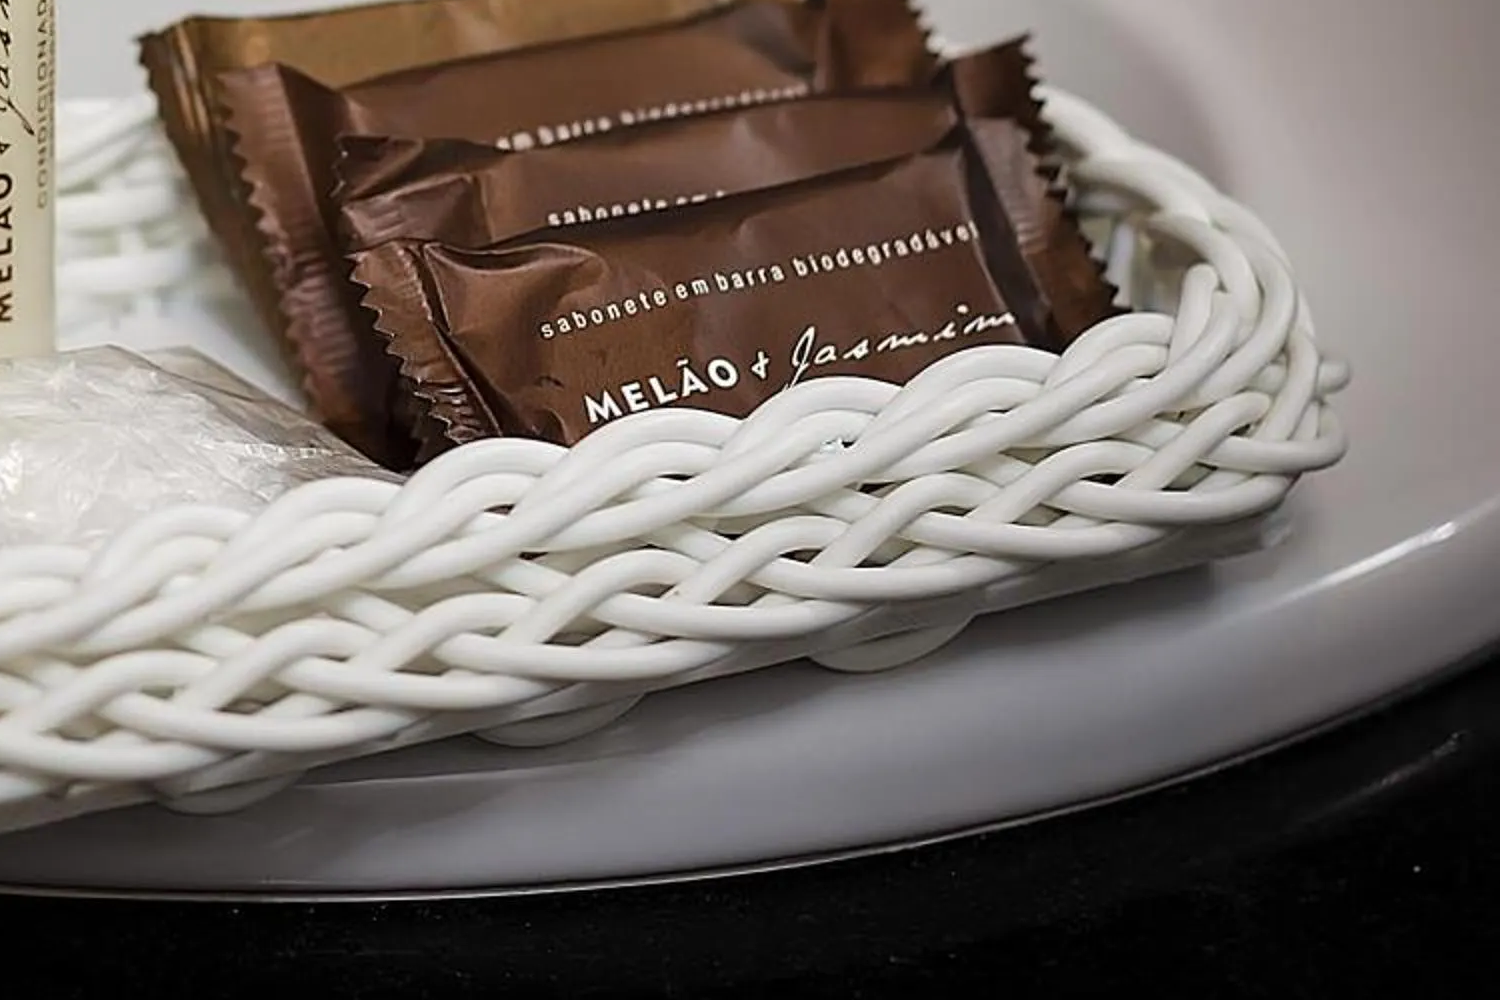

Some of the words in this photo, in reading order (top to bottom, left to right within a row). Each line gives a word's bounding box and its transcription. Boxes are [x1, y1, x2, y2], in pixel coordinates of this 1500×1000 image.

[540, 289, 668, 339] sabonete
[675, 278, 710, 299] em
[714, 263, 786, 292] barra
[792, 220, 981, 277] biodegradável
[583, 358, 740, 424] MELÃO
